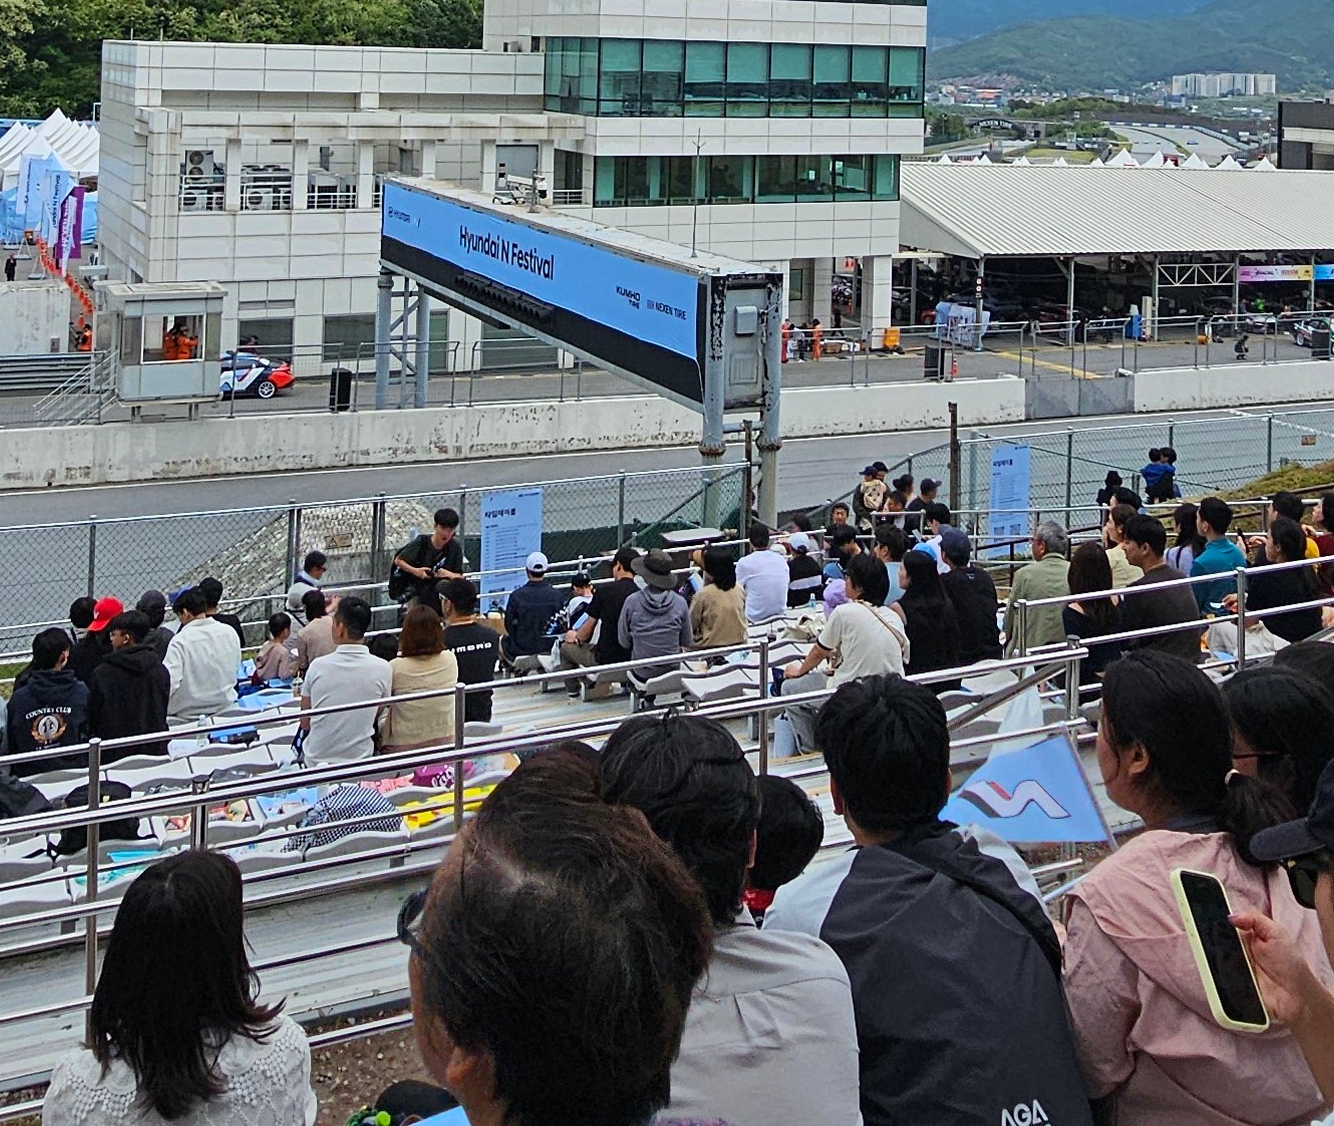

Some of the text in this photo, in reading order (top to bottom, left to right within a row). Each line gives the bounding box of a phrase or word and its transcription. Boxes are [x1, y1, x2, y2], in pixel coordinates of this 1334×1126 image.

[459, 224, 554, 280] Hyundai N Festival
[616, 285, 641, 302] KUMHO
[655, 301, 687, 321] NEXEN TIRE
[25, 705, 72, 720] COUNTRY CLUB
